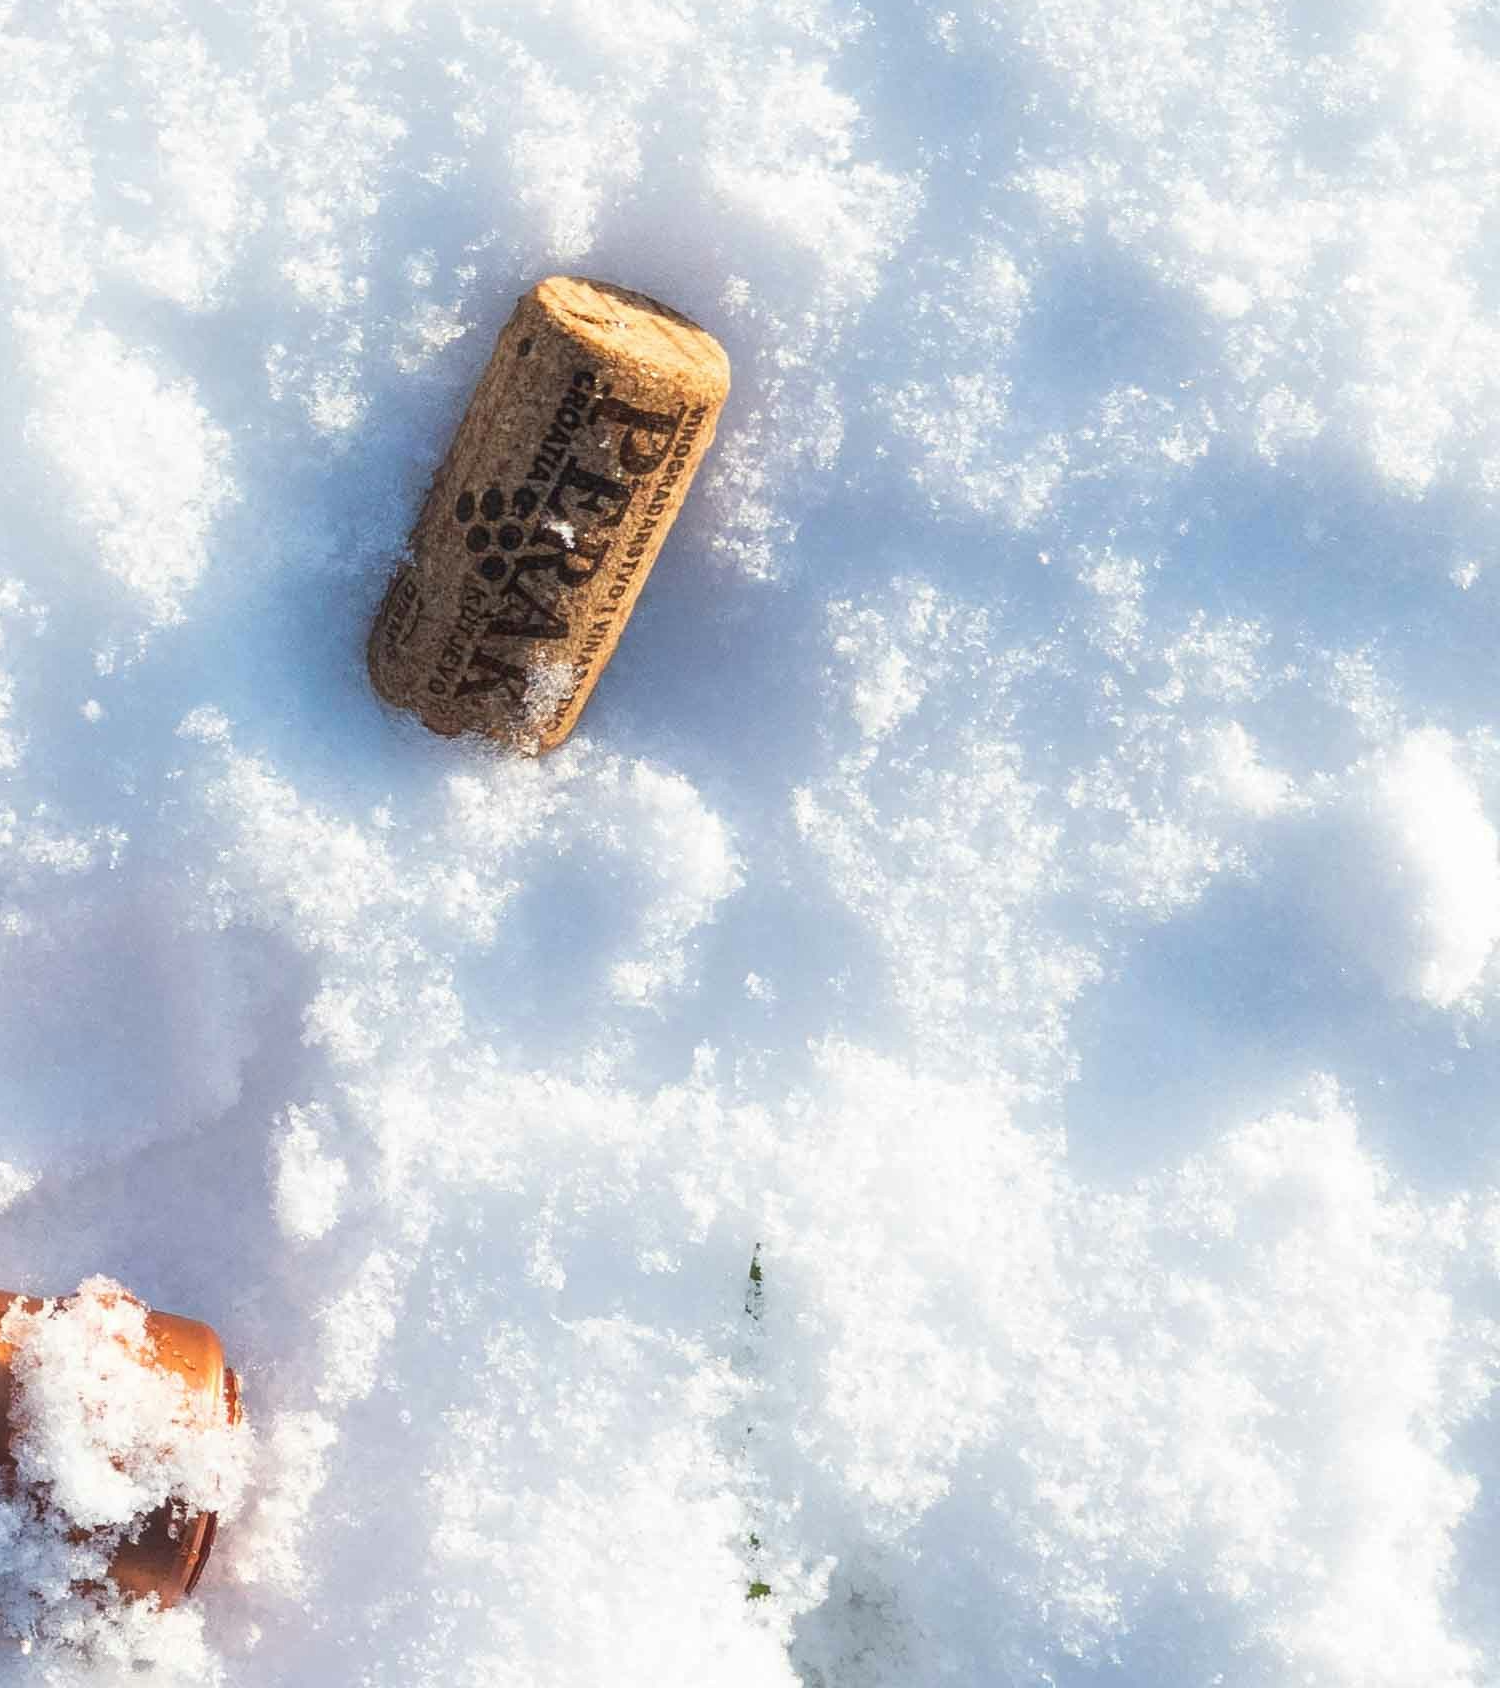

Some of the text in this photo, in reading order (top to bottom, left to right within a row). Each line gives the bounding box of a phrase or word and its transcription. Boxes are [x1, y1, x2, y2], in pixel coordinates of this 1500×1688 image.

[525, 370, 597, 485] CROATIA
[608, 405, 707, 600] VINOGRADARSTVO
[453, 385, 688, 702] PERAK
[427, 580, 492, 696] KUTJEVO
